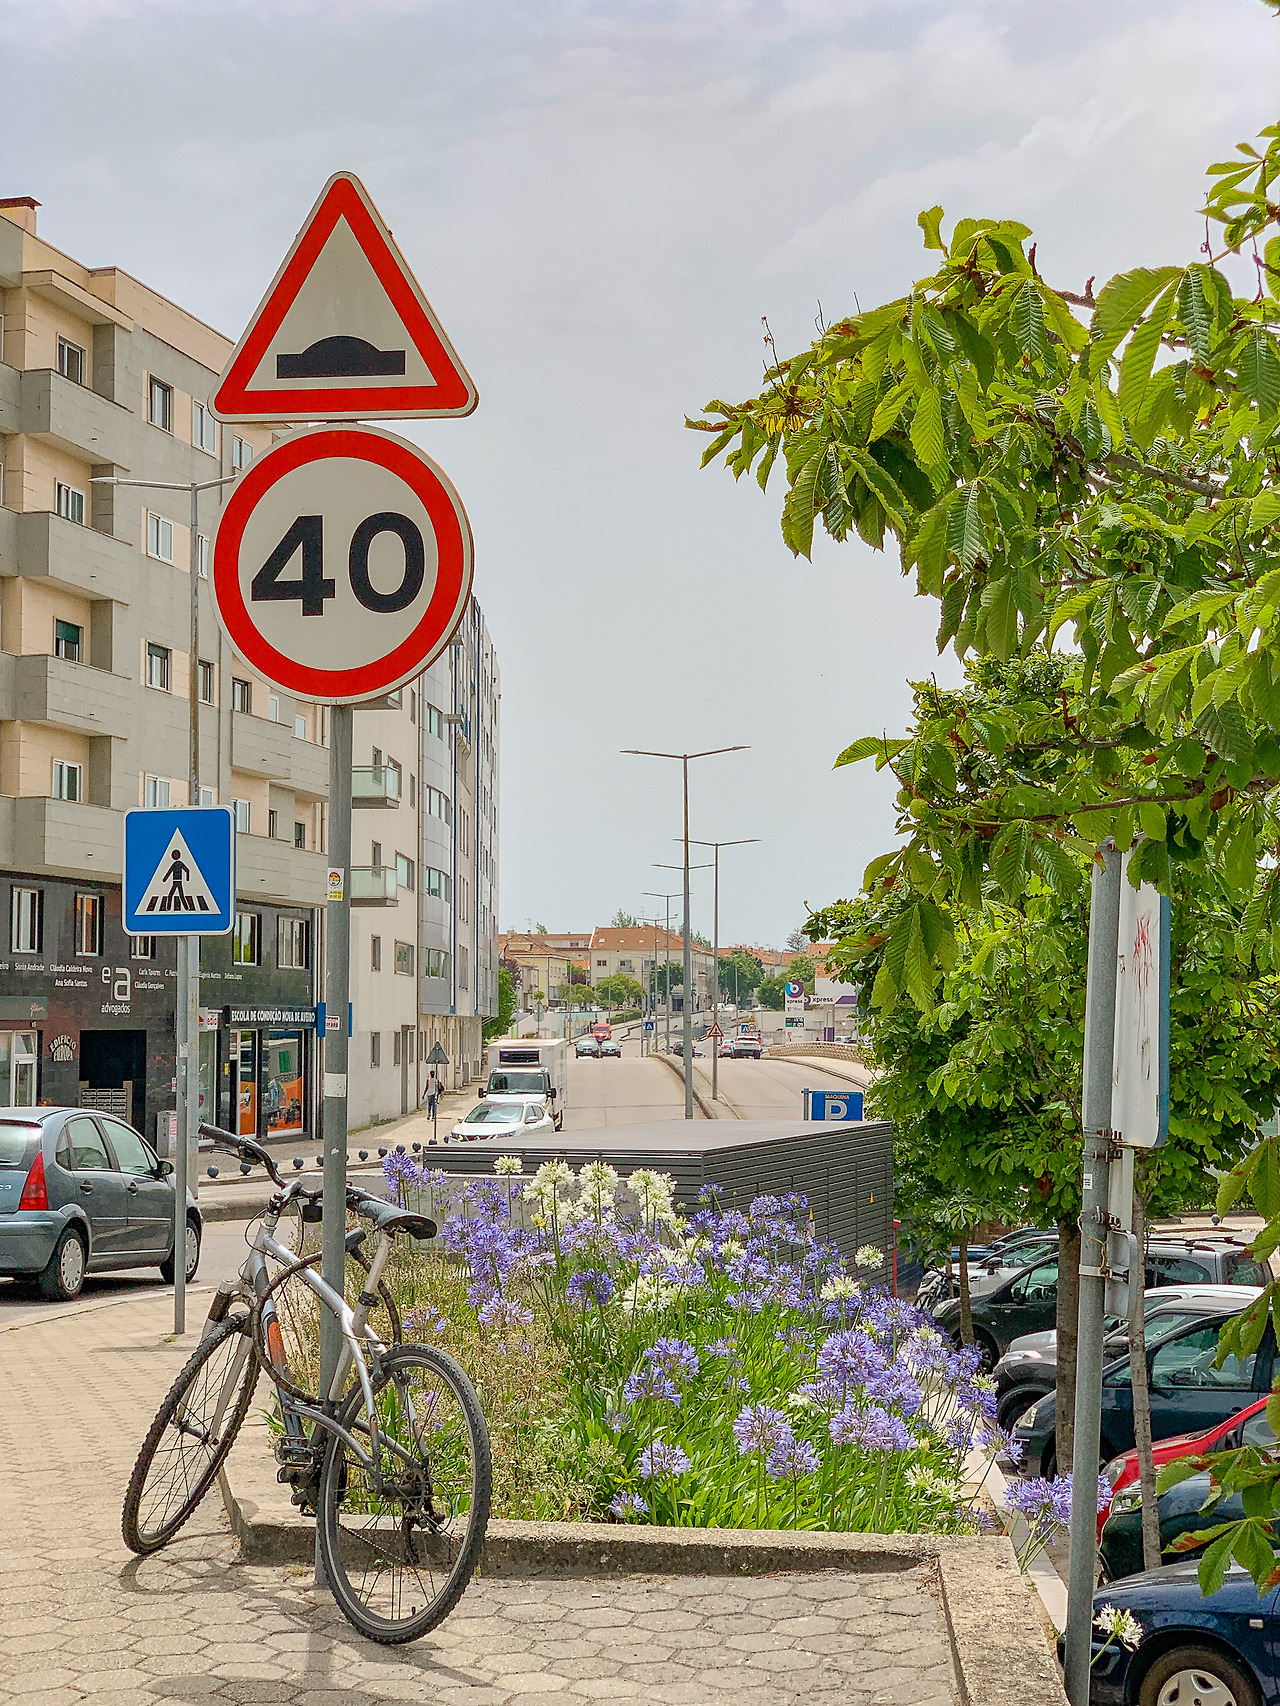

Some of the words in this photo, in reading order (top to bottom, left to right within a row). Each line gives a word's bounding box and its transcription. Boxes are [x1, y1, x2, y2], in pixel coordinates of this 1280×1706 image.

[251, 512, 425, 617] 40
[55, 979, 63, 987] Ana
[64, 979, 74, 987] Sofia
[74, 980, 88, 988] Santos
[101, 1002, 131, 1015] advogados
[231, 1010, 250, 1022] ESCOLA
[250, 1011, 257, 1022] DE
[257, 1008, 282, 1024] CONDUÇÃO
[282, 1011, 294, 1022] NOVA
[294, 1011, 301, 1022] DE
[301, 1012, 316, 1023] AVEIRO
[825, 1099, 847, 1121] P
